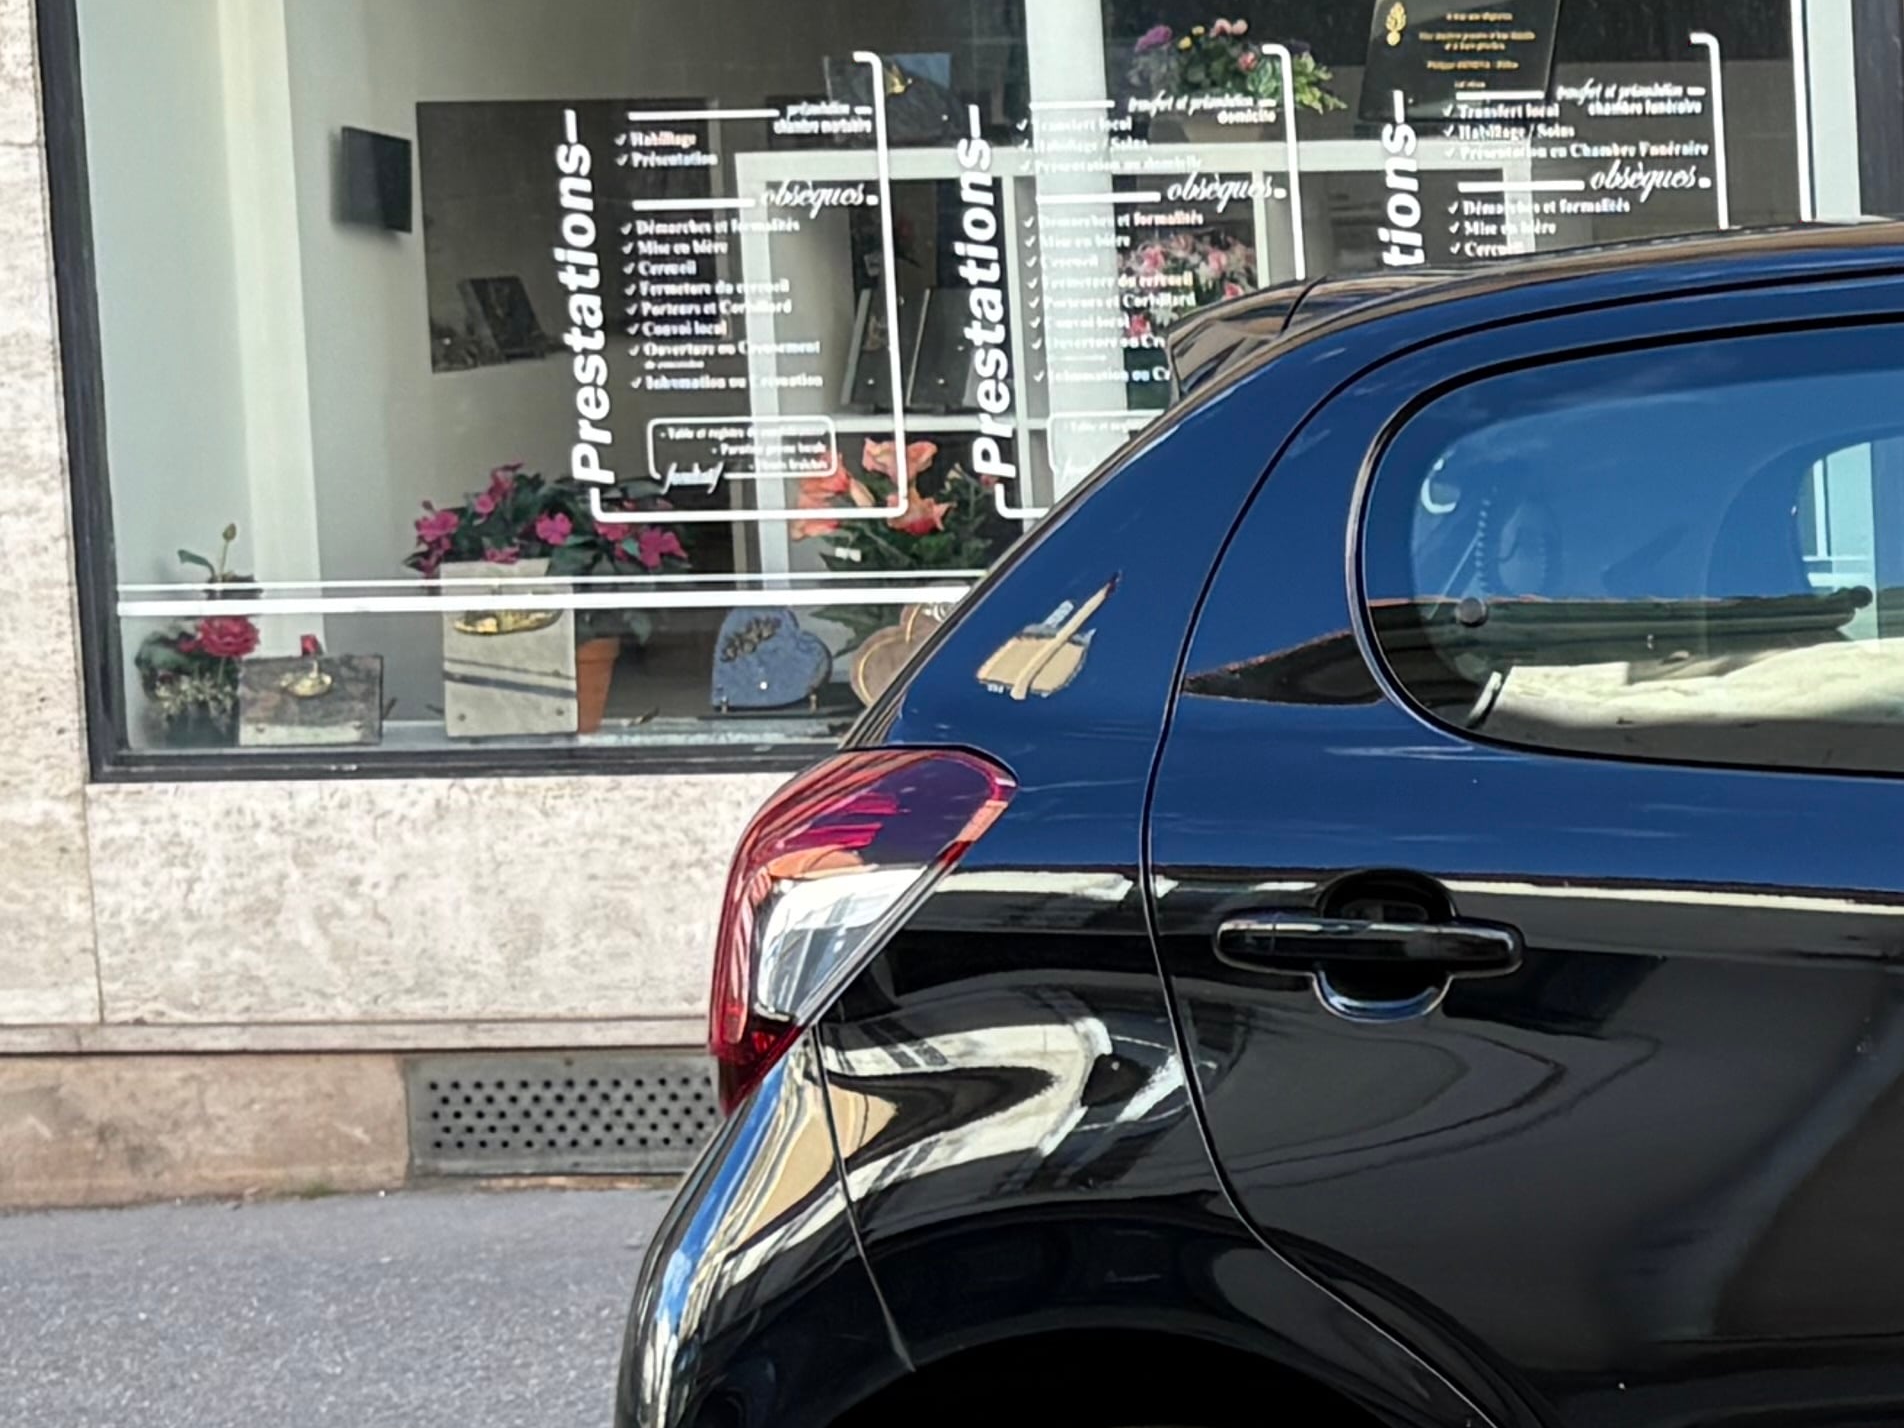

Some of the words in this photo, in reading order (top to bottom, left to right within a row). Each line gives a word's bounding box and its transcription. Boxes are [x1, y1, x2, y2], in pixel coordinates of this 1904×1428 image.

[1459, 103, 1523, 119] Transfert
[1526, 102, 1560, 118] local
[1537, 124, 1575, 139] Soins
[1550, 146, 1567, 158] en
[1569, 143, 1635, 159] Chambre
[1639, 141, 1709, 157] Funéraire
[632, 153, 718, 168] Présentation
[1590, 159, 1697, 203] obsèques
[759, 179, 865, 219] obsèques
[1167, 171, 1273, 214] obsèques
[1377, 121, 1425, 268] tions
[1543, 201, 1555, 214] et
[1559, 197, 1631, 214] formalités
[635, 220, 711, 235] Démarches
[714, 221, 728, 234] et
[1134, 211, 1204, 227] formalités
[1464, 221, 1497, 236] Mise
[637, 240, 670, 255] Mise
[673, 243, 690, 255] en
[692, 238, 728, 255] bière
[637, 260, 697, 276] Cercueil
[639, 281, 711, 296] Fermeture
[715, 279, 733, 295] du
[553, 142, 616, 485] Prestations
[641, 301, 701, 316] Porteurs
[704, 301, 716, 314] et
[953, 138, 1017, 479] Prestations
[642, 321, 692, 337] Convoi
[694, 320, 727, 336] local
[643, 342, 715, 356] Ouverture
[718, 344, 735, 356] ou
[645, 375, 725, 390] Inhumation
[729, 377, 746, 388] ou
